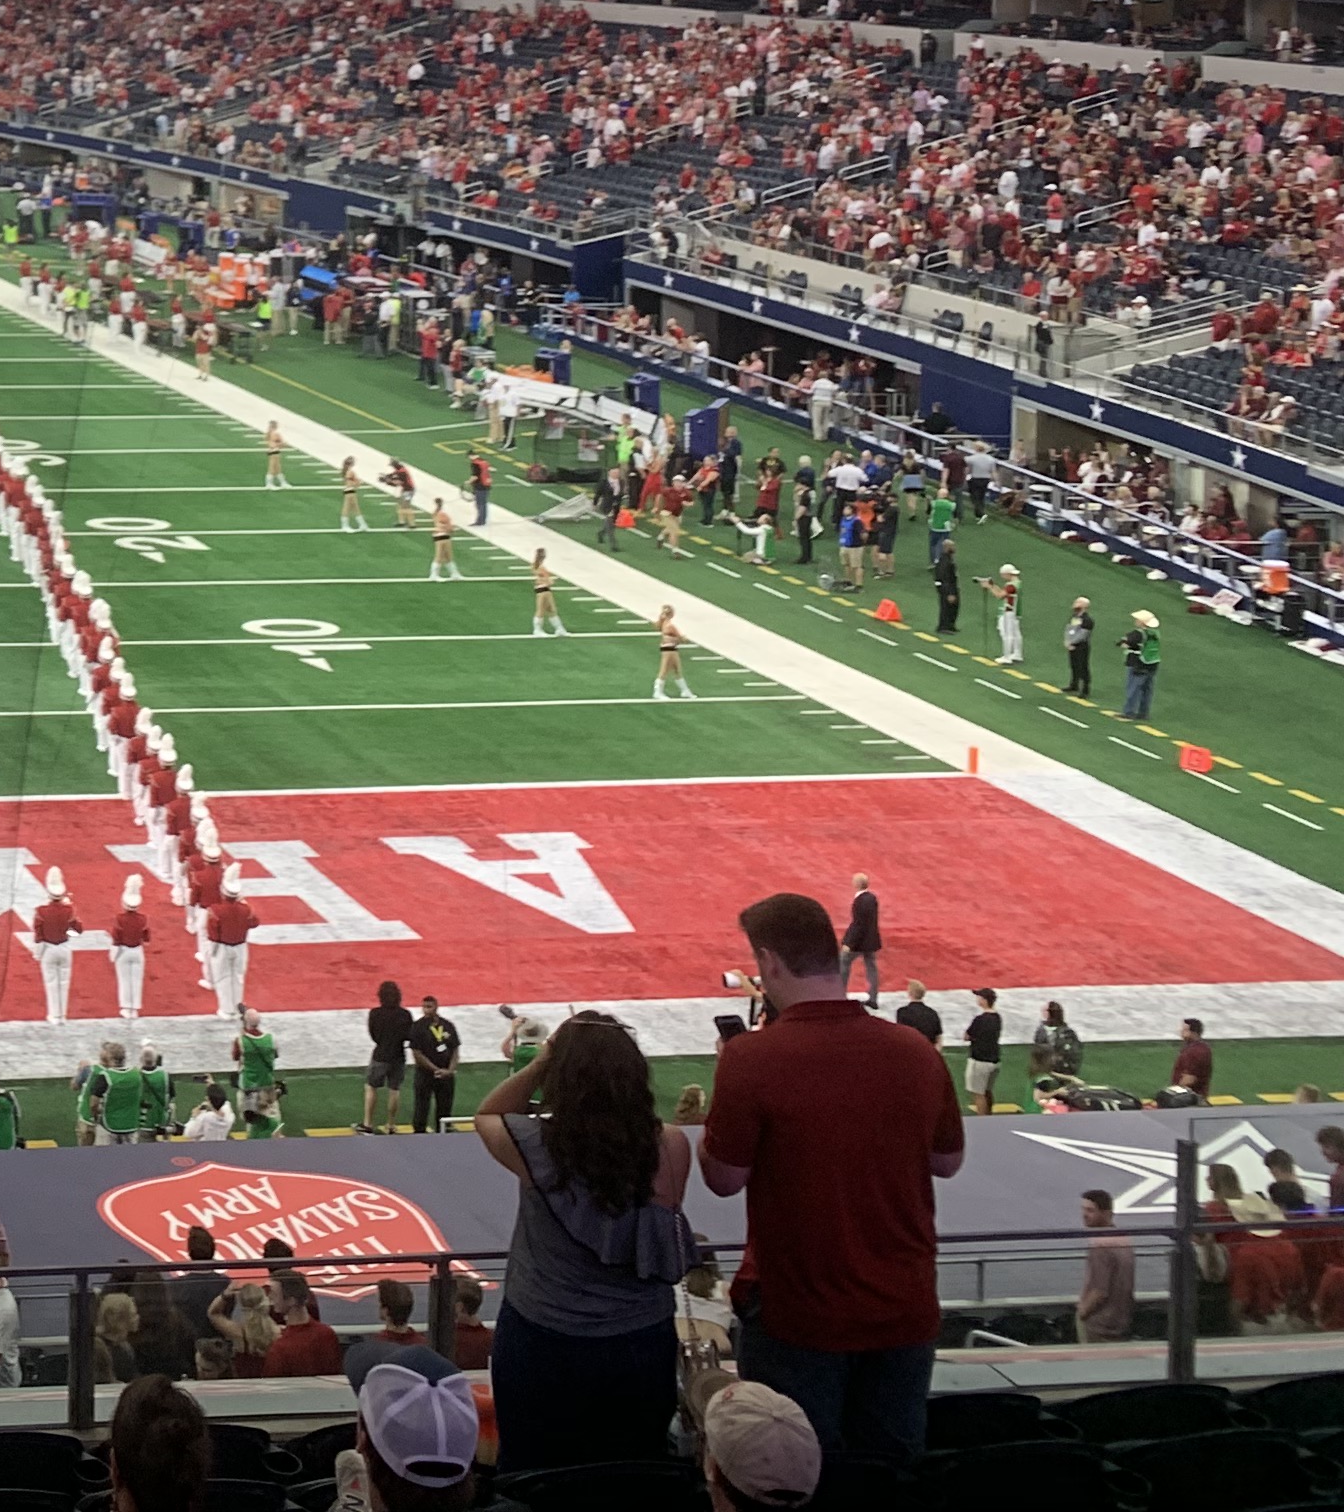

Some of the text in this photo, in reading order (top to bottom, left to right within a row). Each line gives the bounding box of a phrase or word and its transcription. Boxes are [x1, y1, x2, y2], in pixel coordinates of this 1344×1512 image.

[84, 516, 212, 552] 20
[240, 618, 373, 657] 10
[159, 1176, 282, 1242] ARMY
